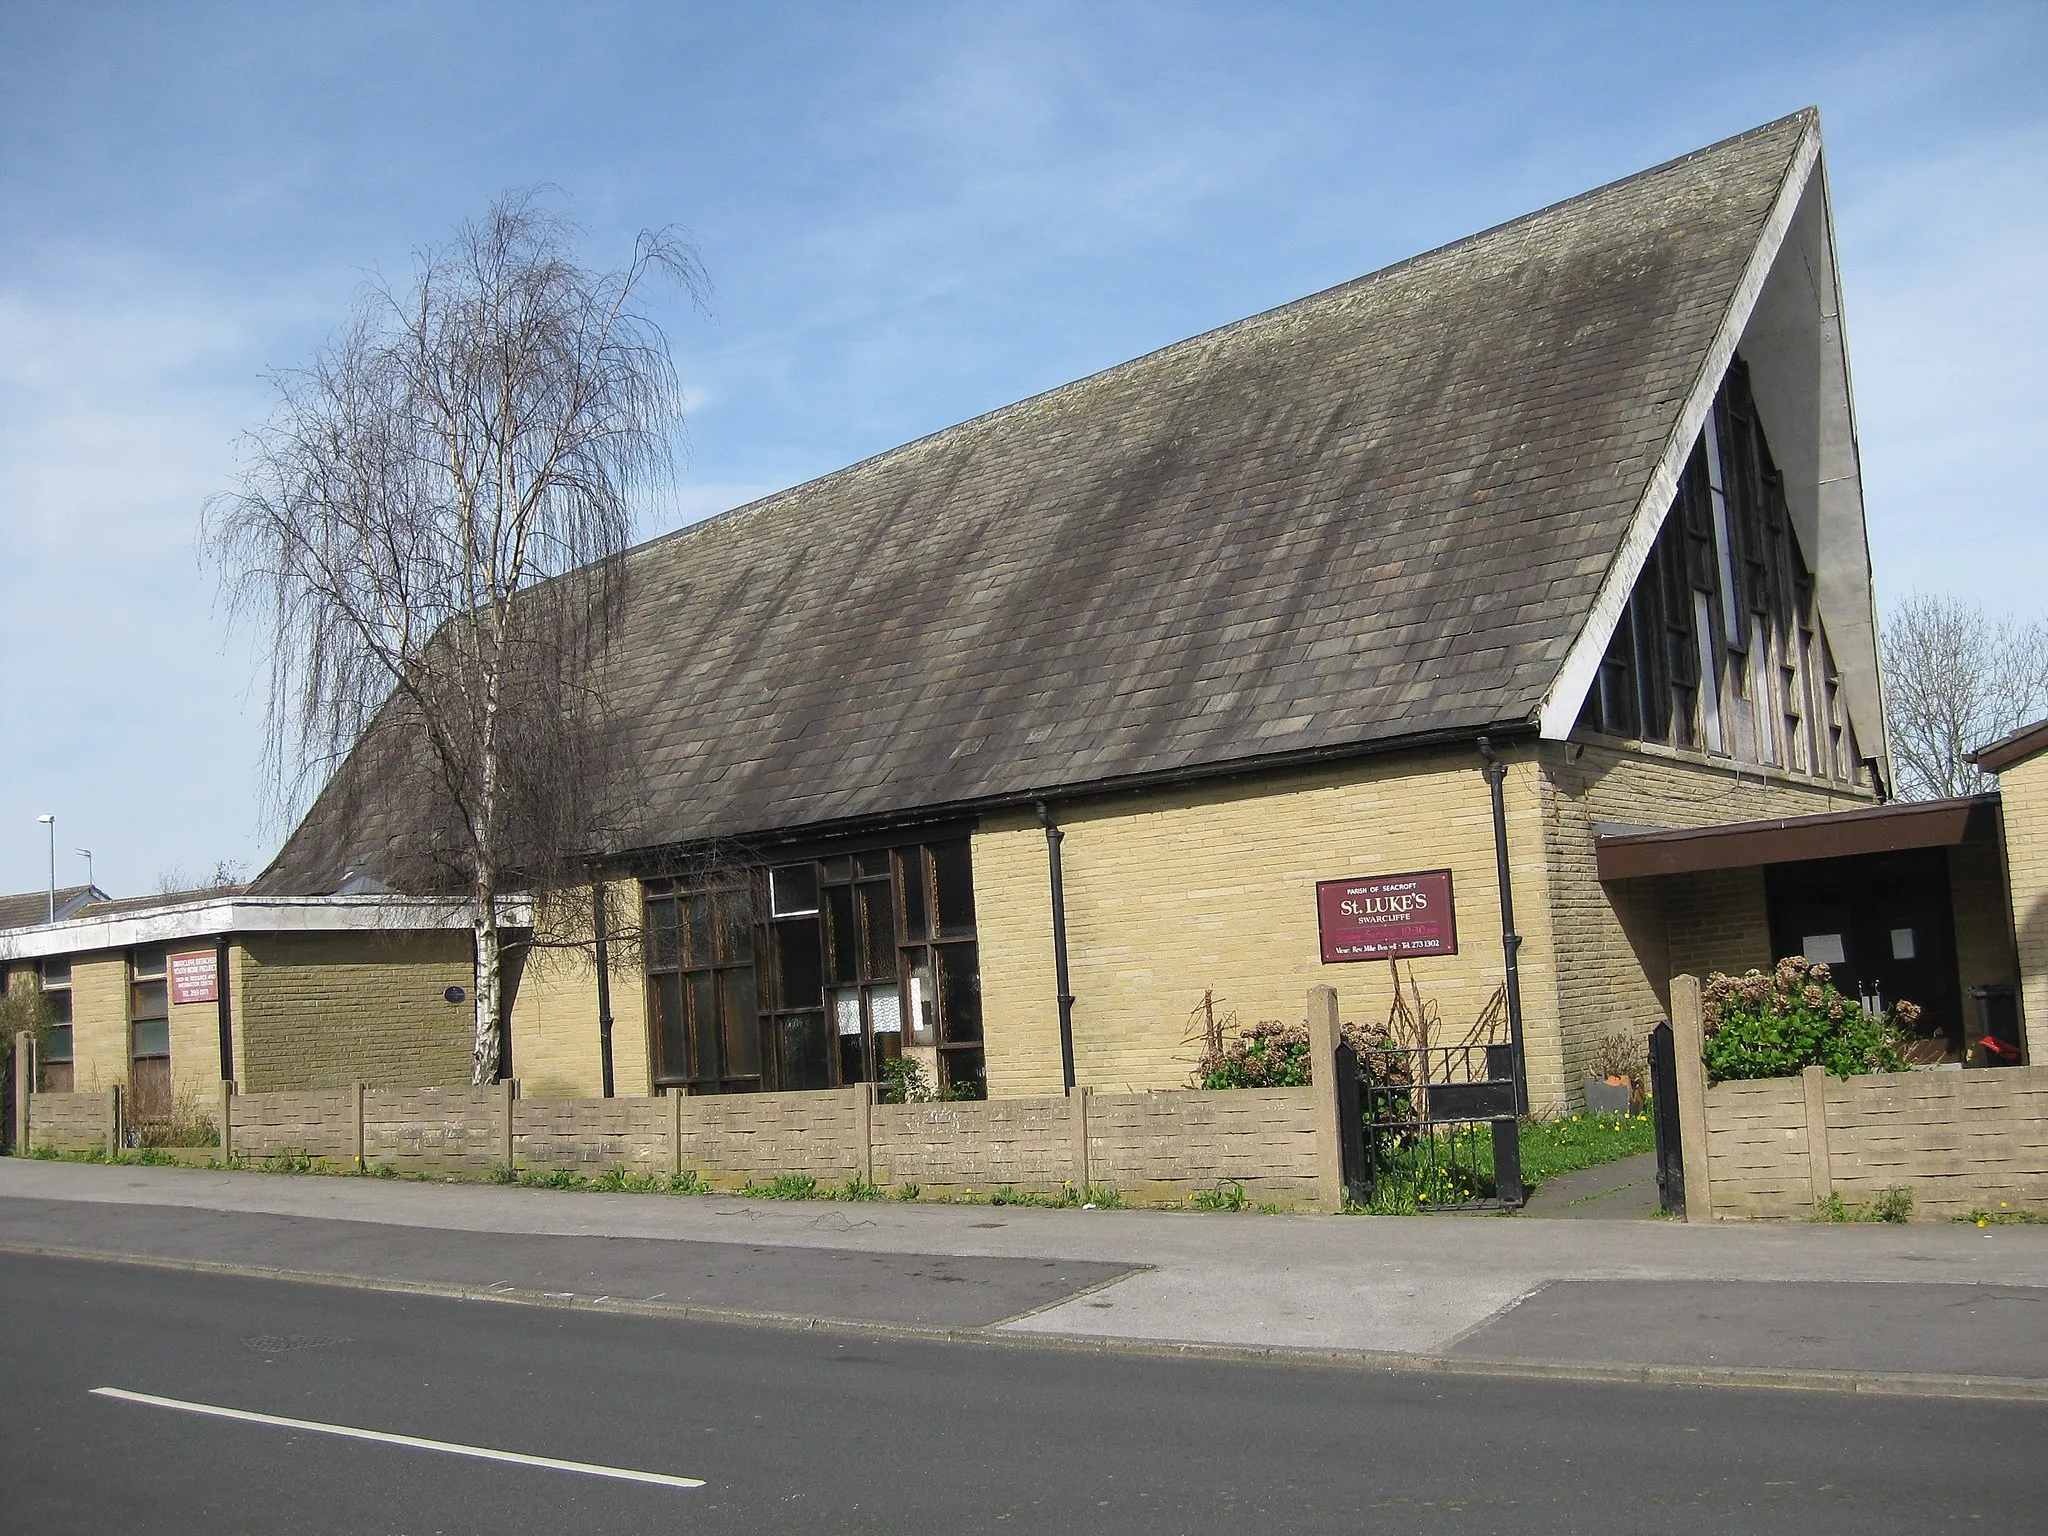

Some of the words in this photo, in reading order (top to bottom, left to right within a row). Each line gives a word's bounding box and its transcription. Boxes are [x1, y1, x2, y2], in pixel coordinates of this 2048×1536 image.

[1382, 883, 1416, 891] SEACROFT
[1340, 900, 1363, 916] St.
[1365, 893, 1427, 913] LUKE'S
[1358, 913, 1411, 924] SWARCLIFFE
